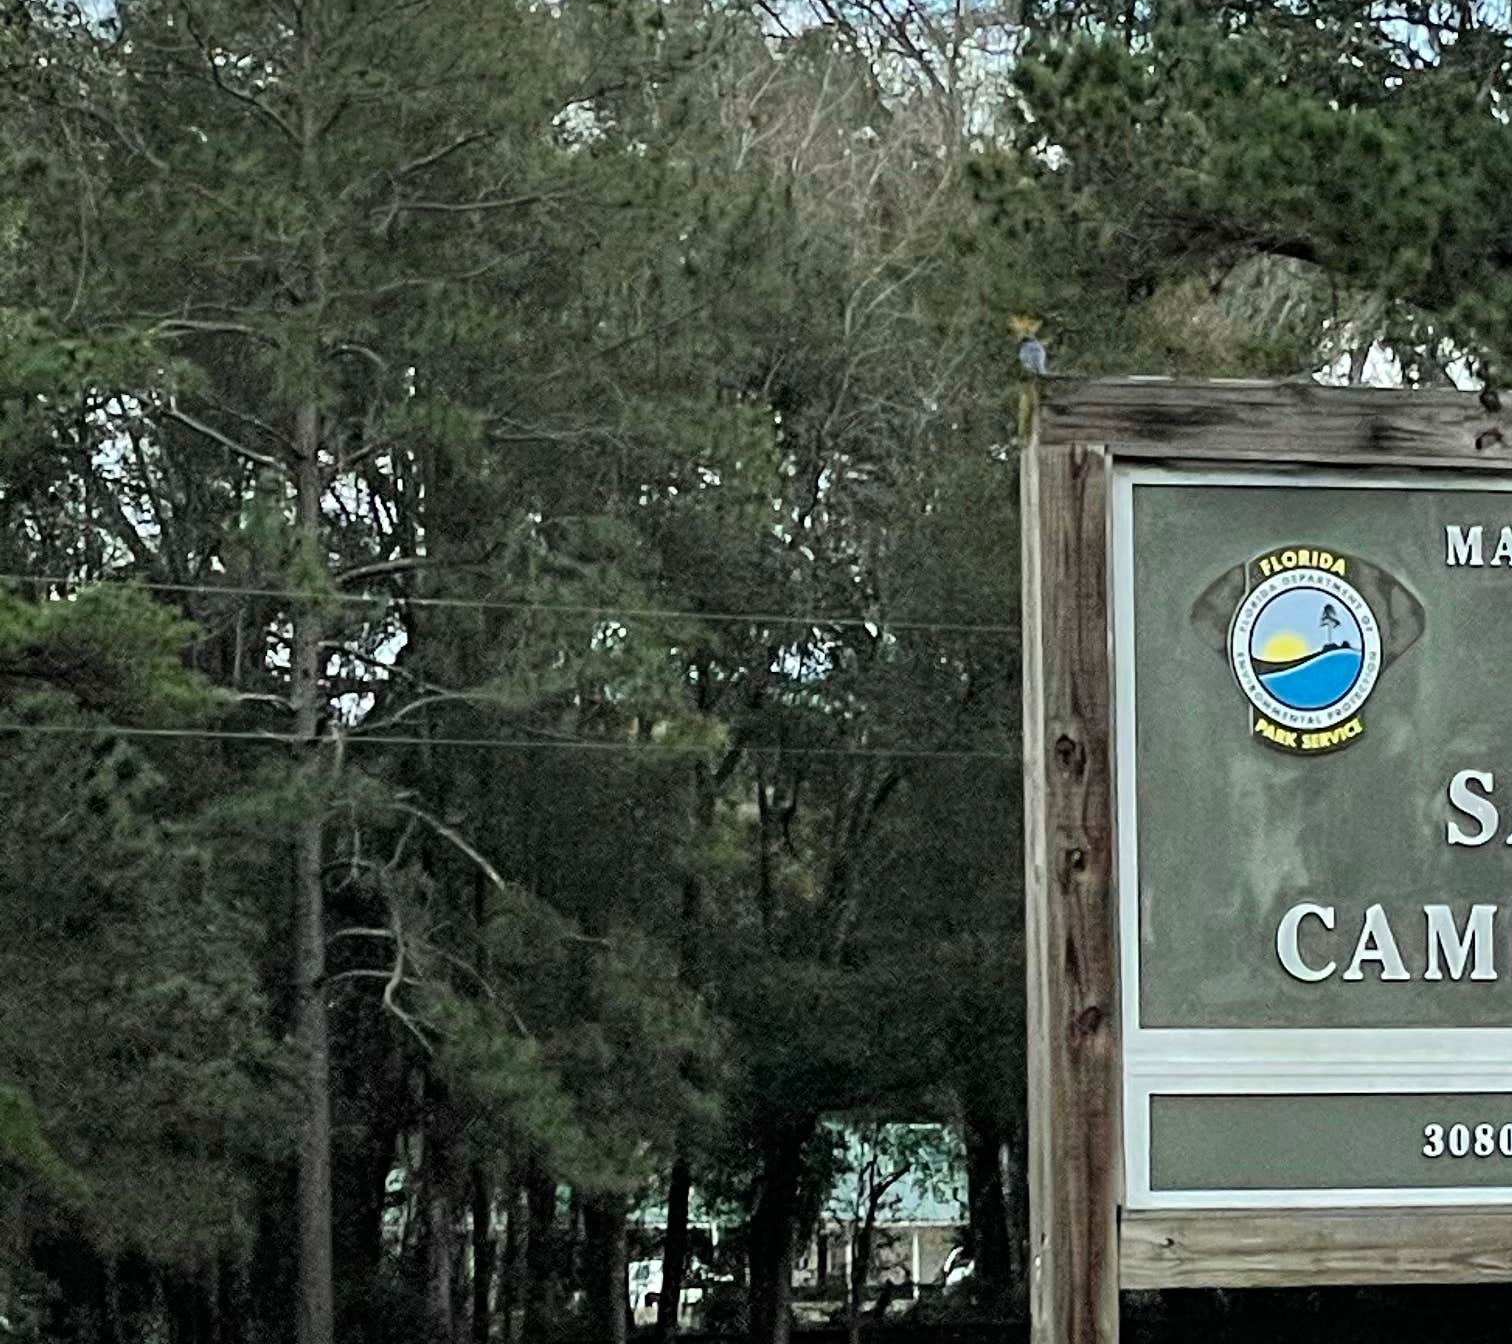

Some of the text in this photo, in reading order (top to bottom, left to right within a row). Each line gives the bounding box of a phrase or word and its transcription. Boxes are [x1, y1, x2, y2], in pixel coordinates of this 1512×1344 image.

[1258, 549, 1346, 576] FLORIDA
[1254, 718, 1364, 750] PARK SERVICE
